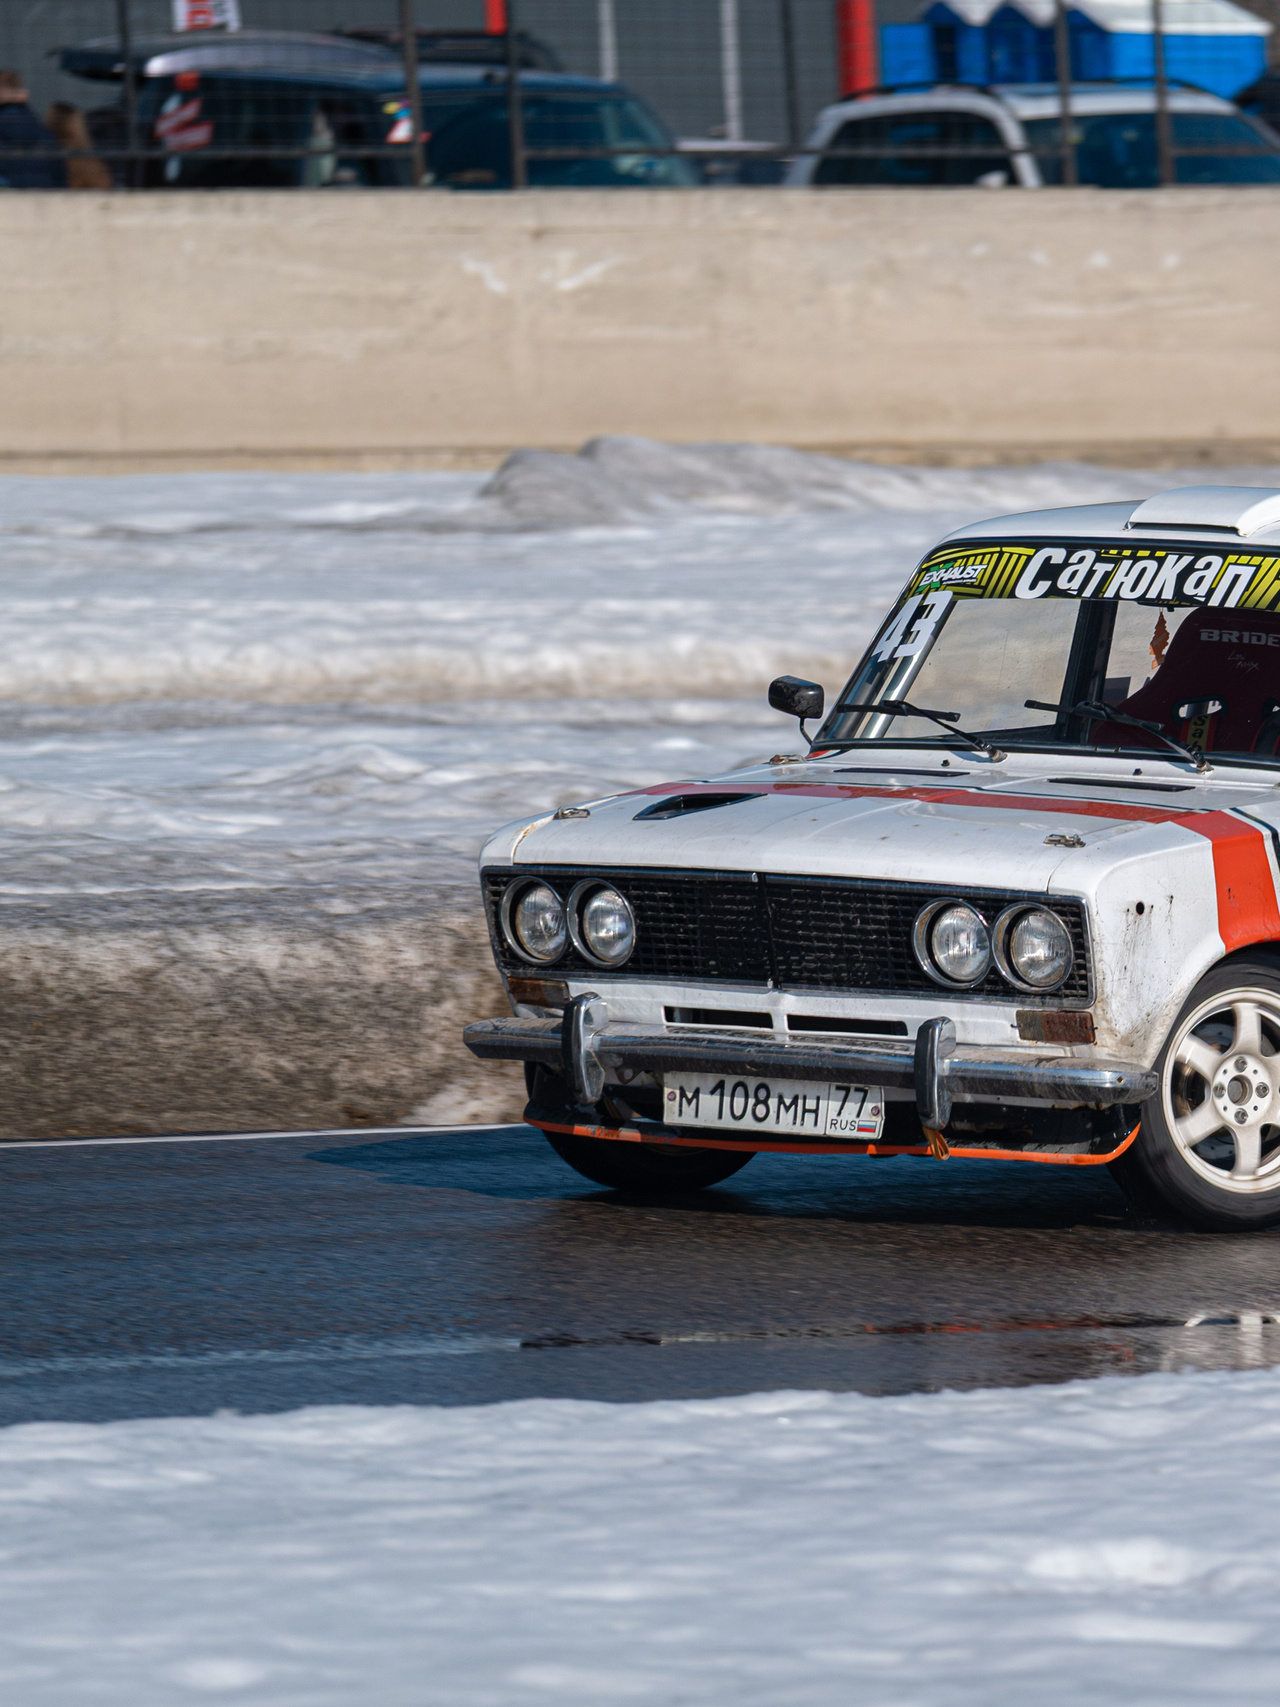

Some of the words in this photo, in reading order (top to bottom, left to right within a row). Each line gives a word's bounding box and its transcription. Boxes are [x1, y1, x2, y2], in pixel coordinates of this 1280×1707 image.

[919, 565, 988, 586] EXHAUST
[871, 590, 954, 662] 43
[834, 1085, 869, 1119] 77
[829, 1118, 857, 1132] RUS
